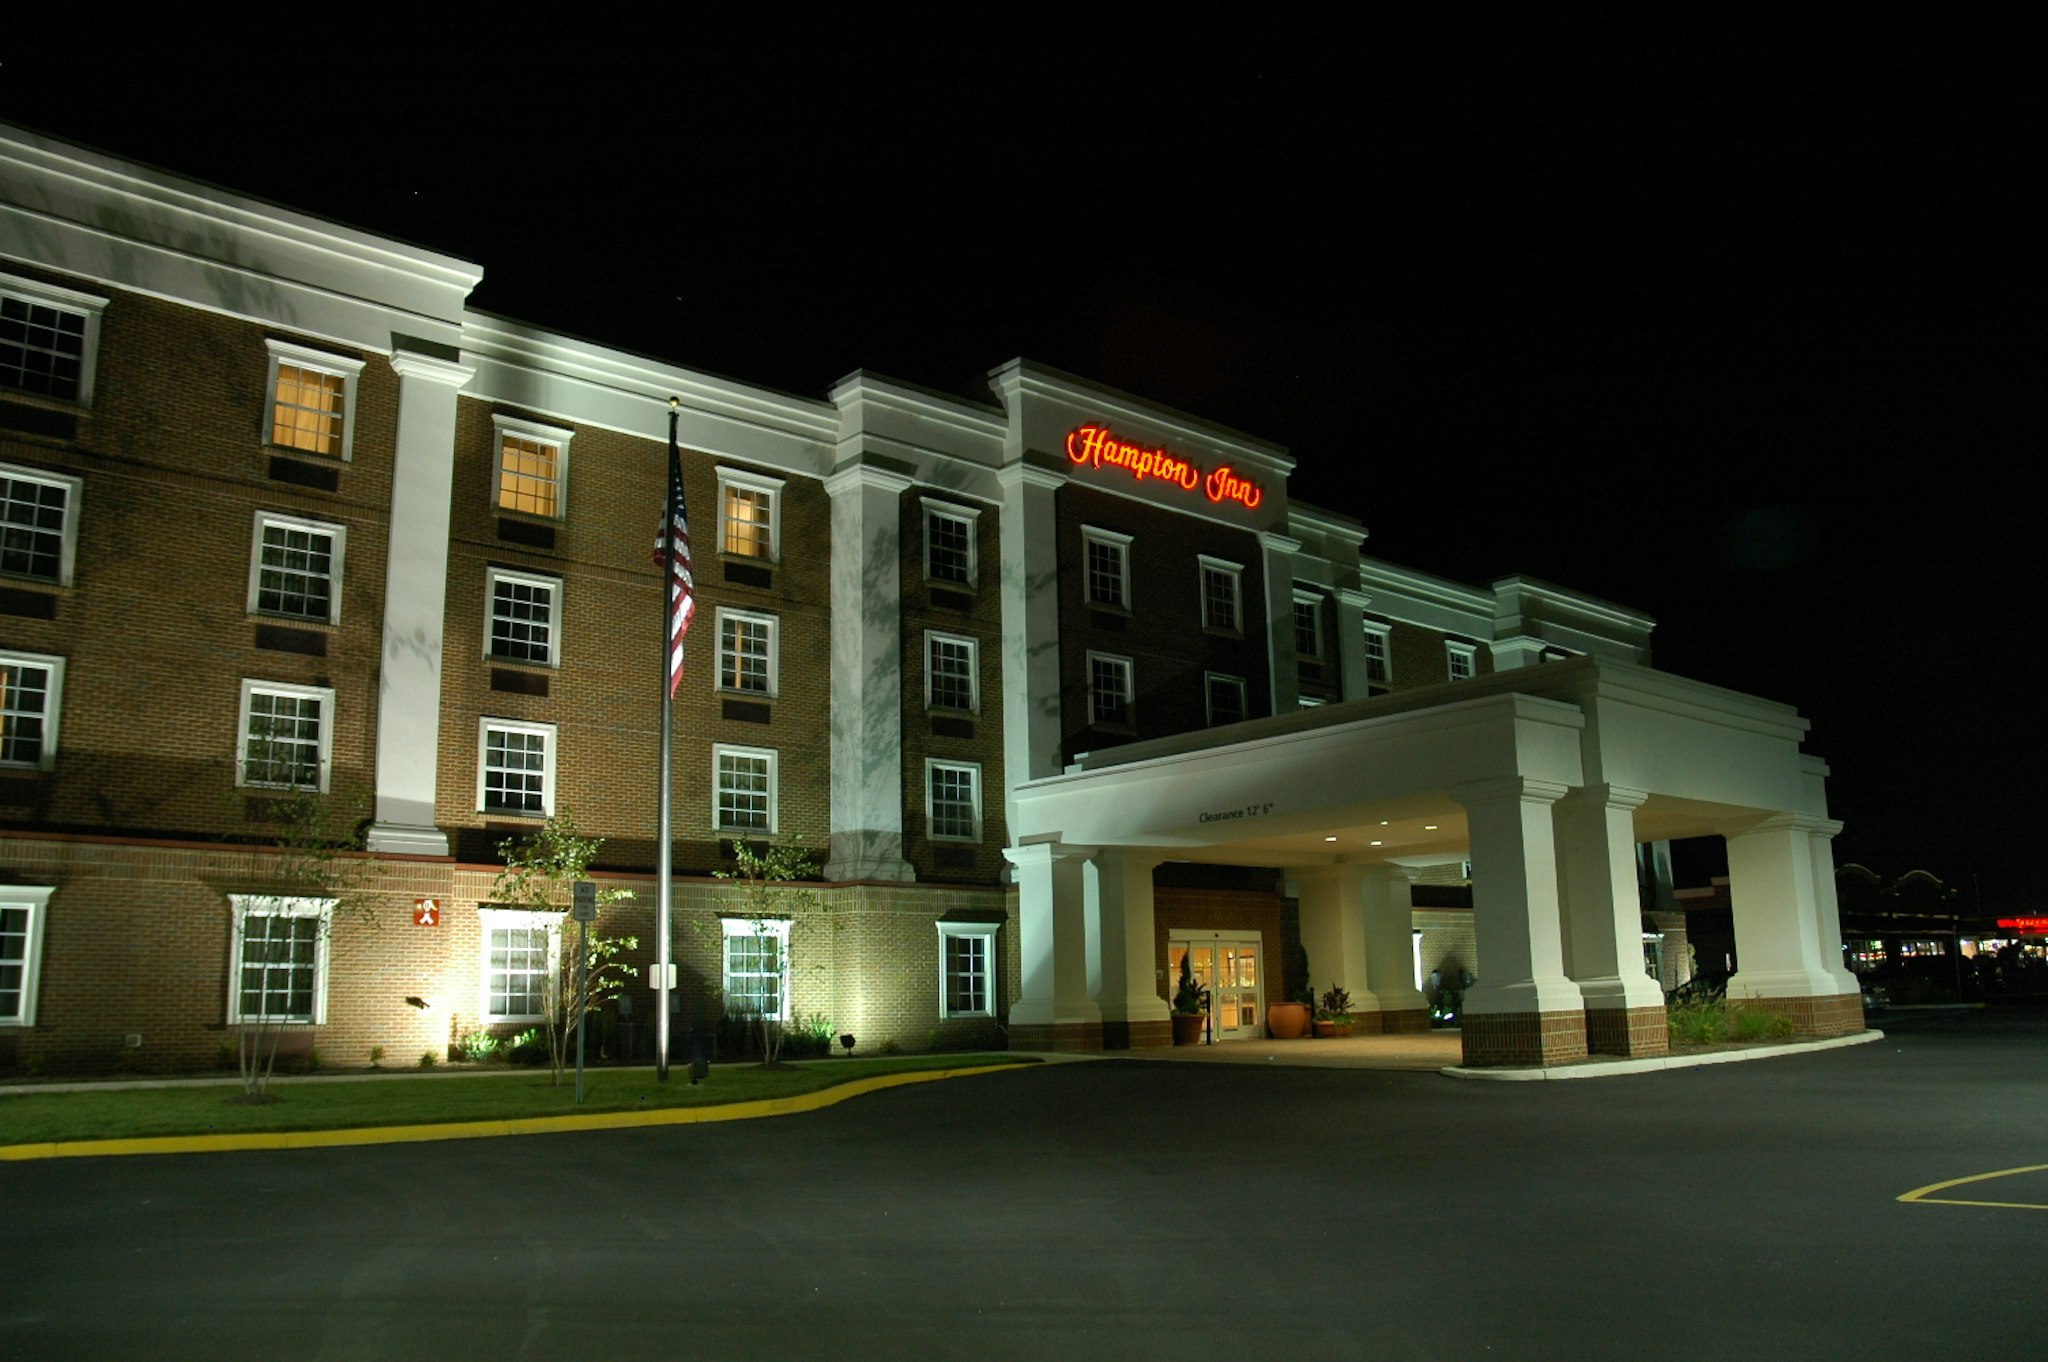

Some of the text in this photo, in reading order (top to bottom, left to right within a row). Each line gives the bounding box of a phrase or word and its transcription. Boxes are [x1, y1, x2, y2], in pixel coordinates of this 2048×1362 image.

[1066, 426, 1260, 508] Hampton Inn
[1199, 809, 1244, 823] Clearance
[1246, 804, 1260, 816] 12'
